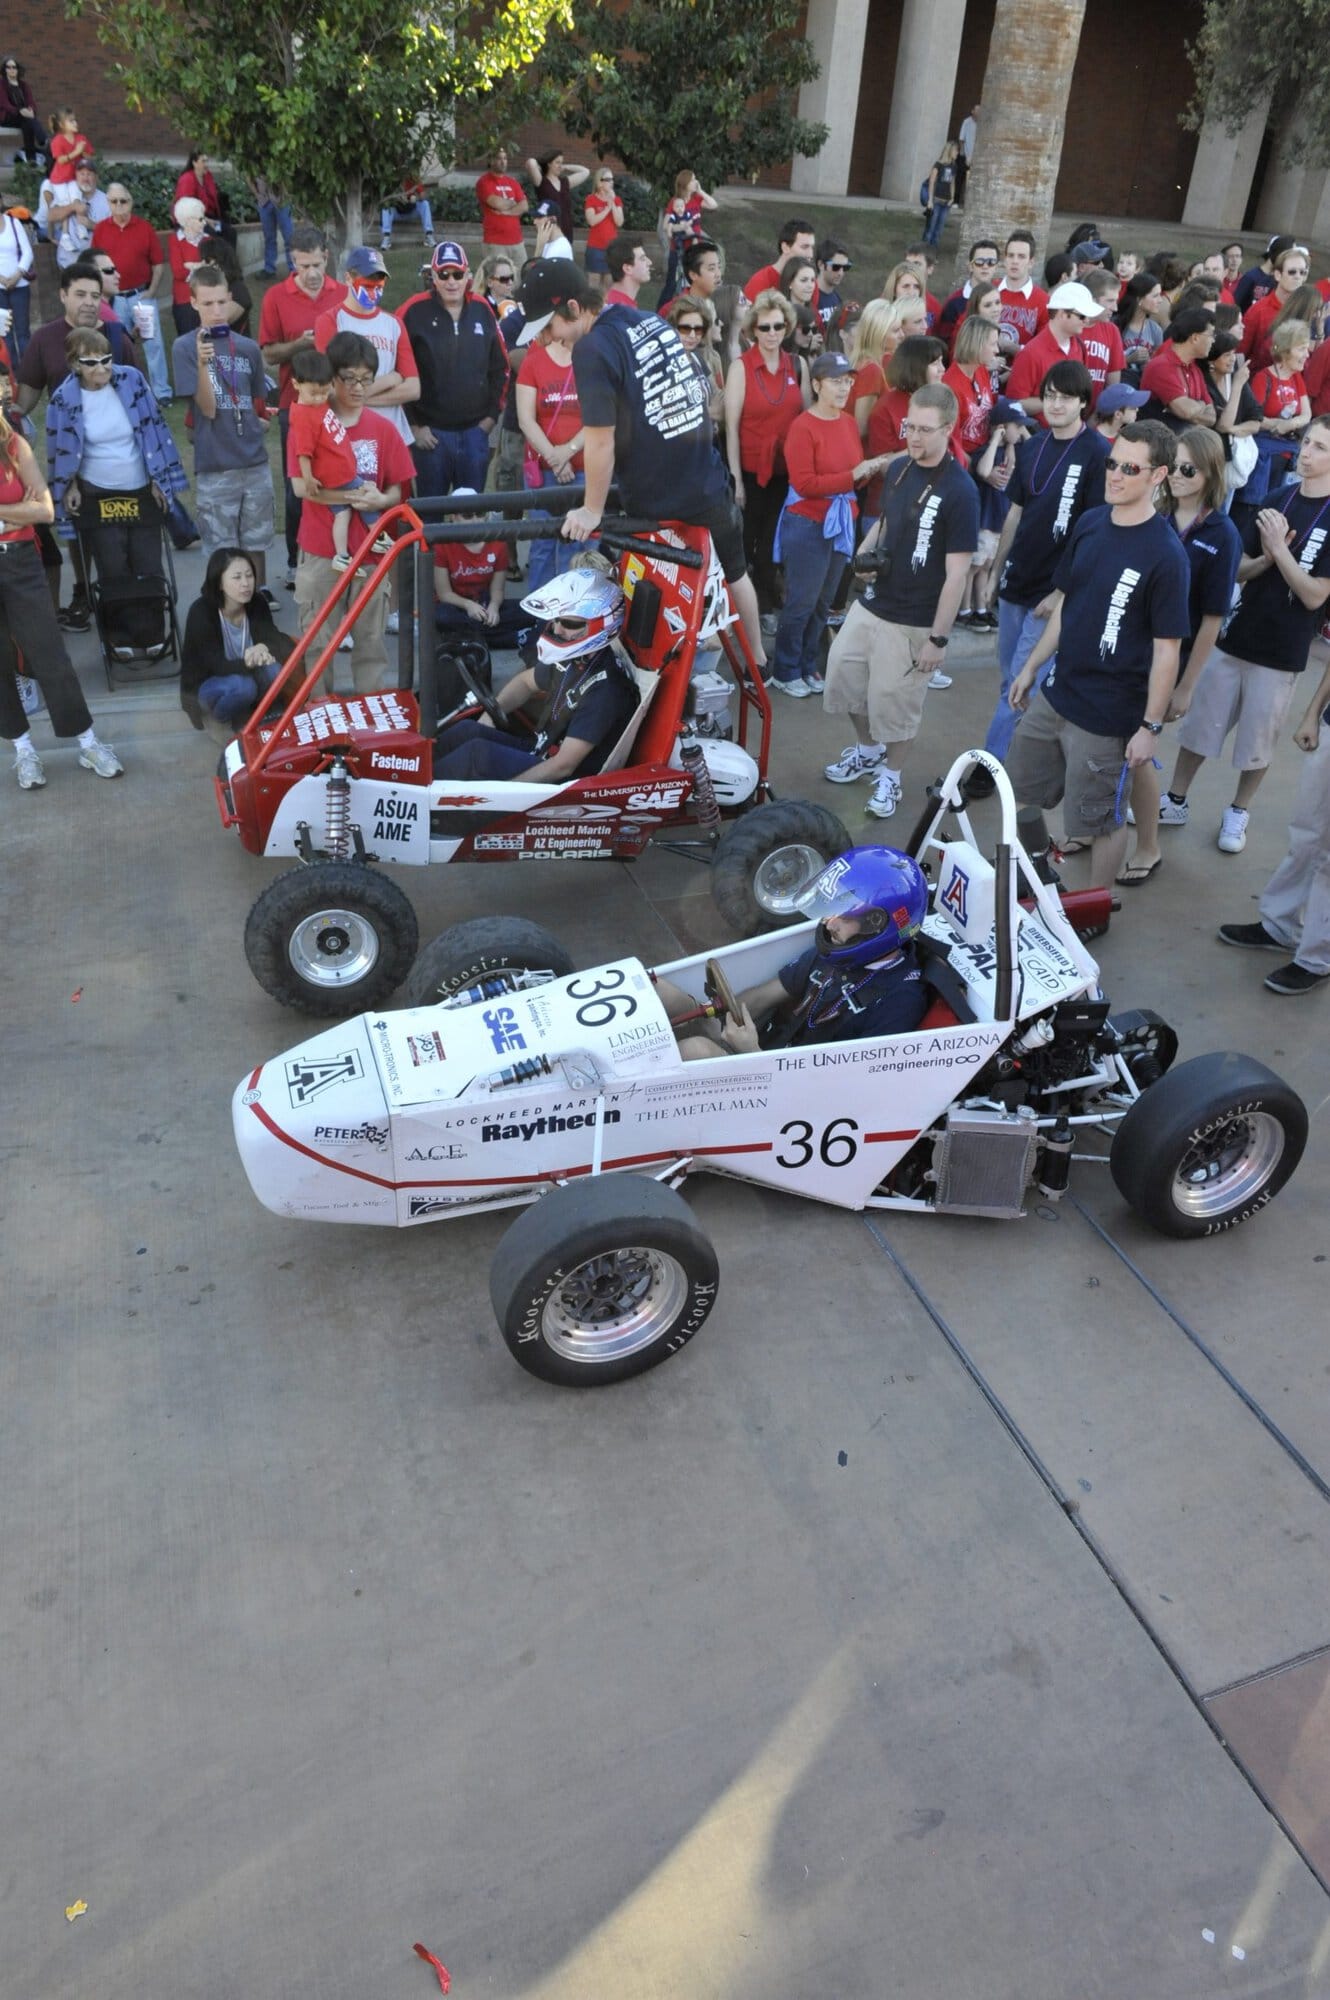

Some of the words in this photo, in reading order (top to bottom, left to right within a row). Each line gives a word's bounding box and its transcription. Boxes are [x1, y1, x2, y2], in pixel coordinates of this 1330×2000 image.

[100, 502, 139, 518] LONG
[1111, 582, 1134, 608] Baja
[1100, 606, 1126, 655] Racing
[371, 752, 420, 772] Fastenal
[374, 798, 418, 821] ASUA
[625, 789, 684, 810] SAE
[374, 822, 412, 842] AME
[526, 826, 574, 836] Lockheed
[577, 825, 612, 835] Martin
[518, 849, 612, 860] POLARIS
[534, 838, 546, 848] AZ
[548, 837, 602, 850] Engineering
[940, 864, 970, 928] A
[1028, 927, 1070, 966] DIVERSIFIED
[566, 969, 638, 1028] 36
[482, 1007, 528, 1054] SAE
[608, 1020, 668, 1048] LINDEL
[612, 1033, 670, 1058] ENGINEERING
[776, 1057, 806, 1072] THE
[813, 1045, 899, 1068] UNIVERSITY
[902, 1043, 924, 1056] OF
[928, 1033, 1000, 1053] ARIZONA
[868, 1056, 953, 1073] azengineering
[284, 1048, 364, 1109] A
[701, 1075, 752, 1086] ENGINEERING
[446, 1107, 542, 1128] LOCKHEED
[552, 1095, 620, 1112] MARTN
[635, 1108, 669, 1122] THE
[672, 1102, 726, 1118] METAL
[730, 1098, 768, 1110] MAN
[314, 1126, 360, 1139] PETER
[482, 1109, 620, 1142] Raytheon
[408, 1144, 464, 1160] ACE
[776, 1118, 859, 1168] 36
